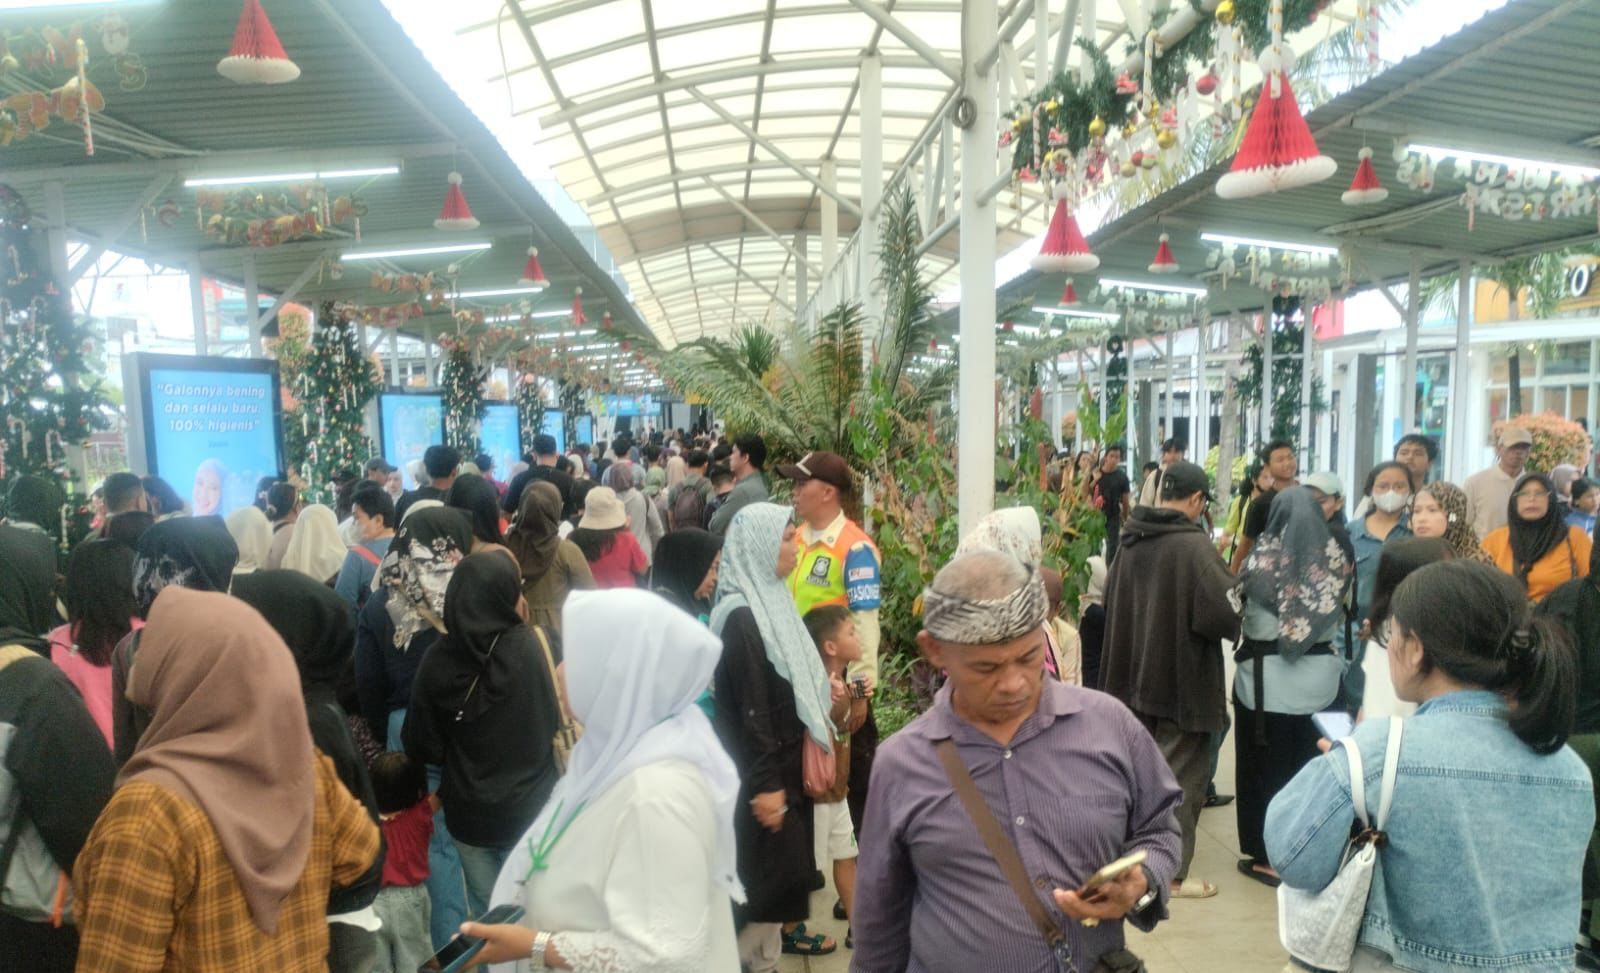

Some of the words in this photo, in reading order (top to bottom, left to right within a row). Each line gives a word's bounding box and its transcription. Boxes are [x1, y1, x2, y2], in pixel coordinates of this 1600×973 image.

[227, 386, 265, 400] bening
[165, 401, 189, 414] dan
[192, 402, 229, 414] selalu
[170, 420, 204, 432] 100%
